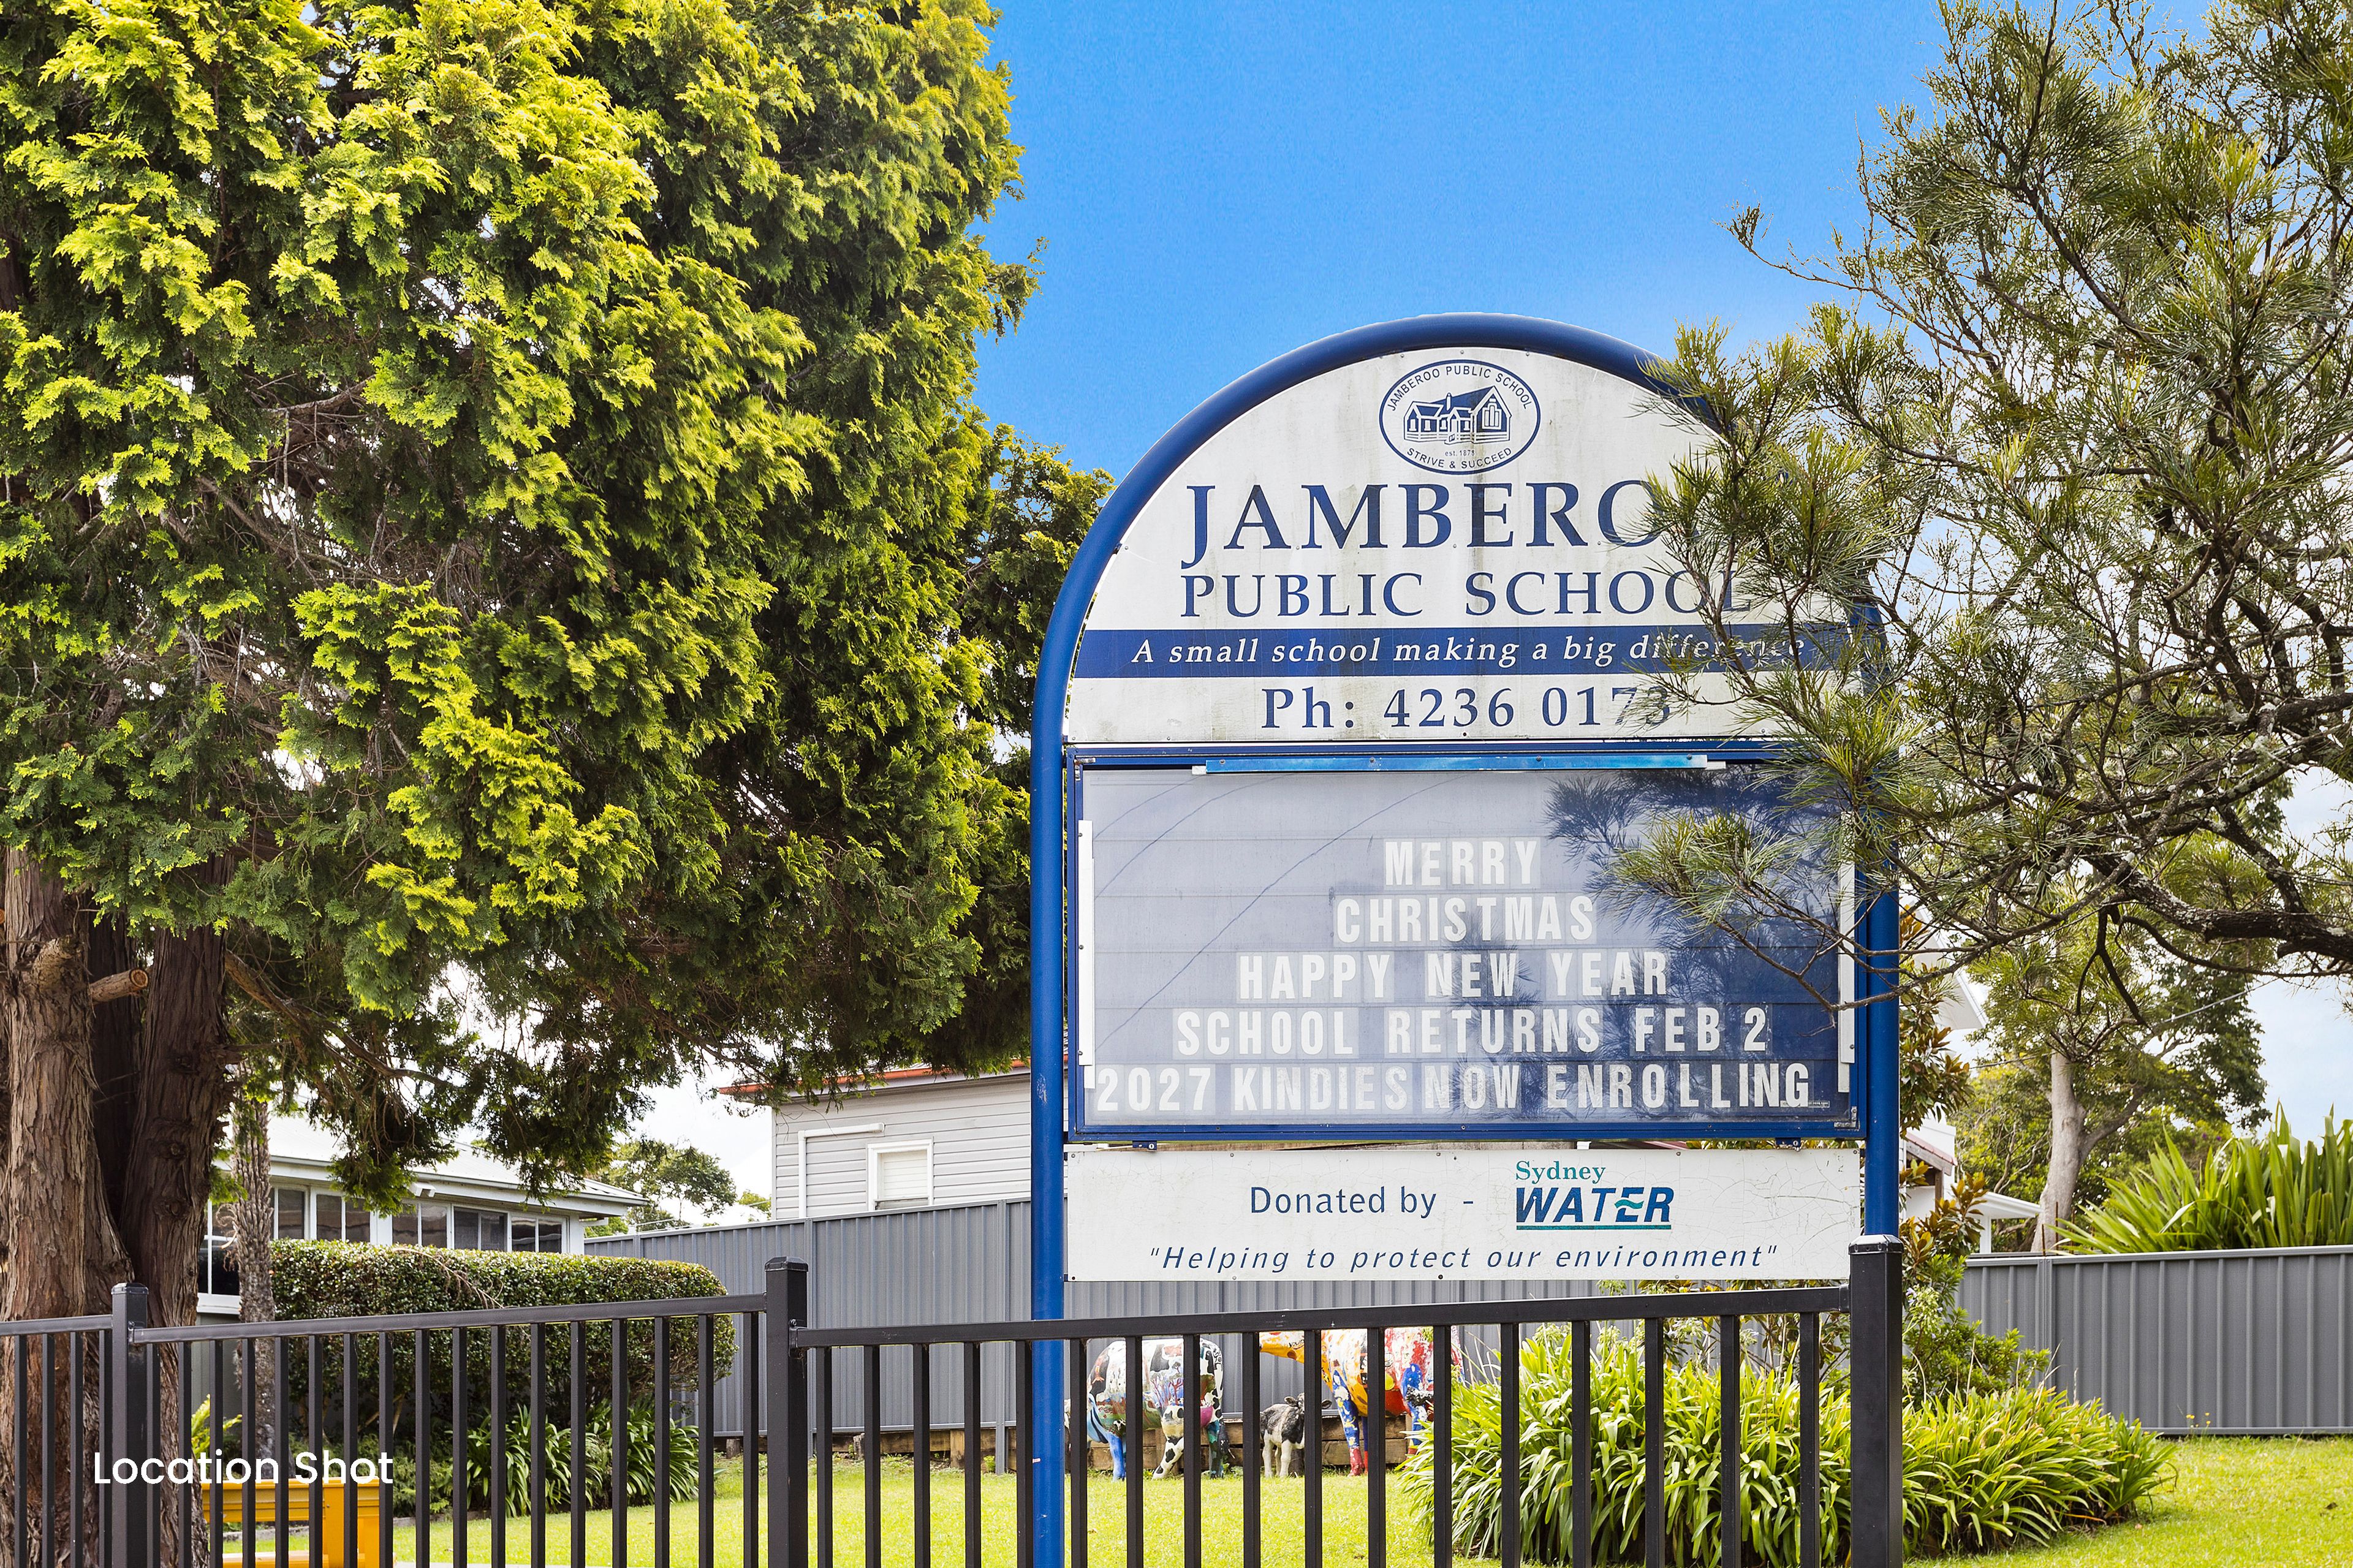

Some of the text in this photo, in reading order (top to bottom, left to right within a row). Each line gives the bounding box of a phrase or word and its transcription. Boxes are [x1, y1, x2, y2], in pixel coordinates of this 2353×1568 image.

[1387, 365, 1532, 411] JAMBEROO PUBLIC SCHOOL
[1407, 447, 1444, 468] STRIVE
[1461, 447, 1512, 469] SUCCEED
[1181, 478, 1748, 569] JAMBERO
[1180, 570, 1751, 618] PUBLIC SCHOOL
[1131, 638, 1154, 663] A
[1169, 638, 1259, 662] small
[1271, 637, 1381, 662] school
[1393, 637, 1519, 668] making
[1532, 643, 1547, 660] a
[1563, 635, 1616, 667] big
[1262, 686, 1670, 729] Ph: 4236 0173
[1385, 841, 1537, 886] MERRY
[1336, 896, 1593, 942] CHRISTMAS
[1239, 952, 1667, 1000] HAPPY NEW YEAR
[1177, 1007, 1767, 1056] SCHOOL RETURNS FEB 2
[1097, 1063, 1809, 1112] 2027 KINDIES NOW ENROLLING
[1516, 1161, 1605, 1184] Sydney
[1251, 1186, 1385, 1214] Donated
[1401, 1186, 1436, 1218] by
[1516, 1187, 1675, 1223] WATER
[1150, 1244, 1777, 1273] "Helping to protect our environment"
